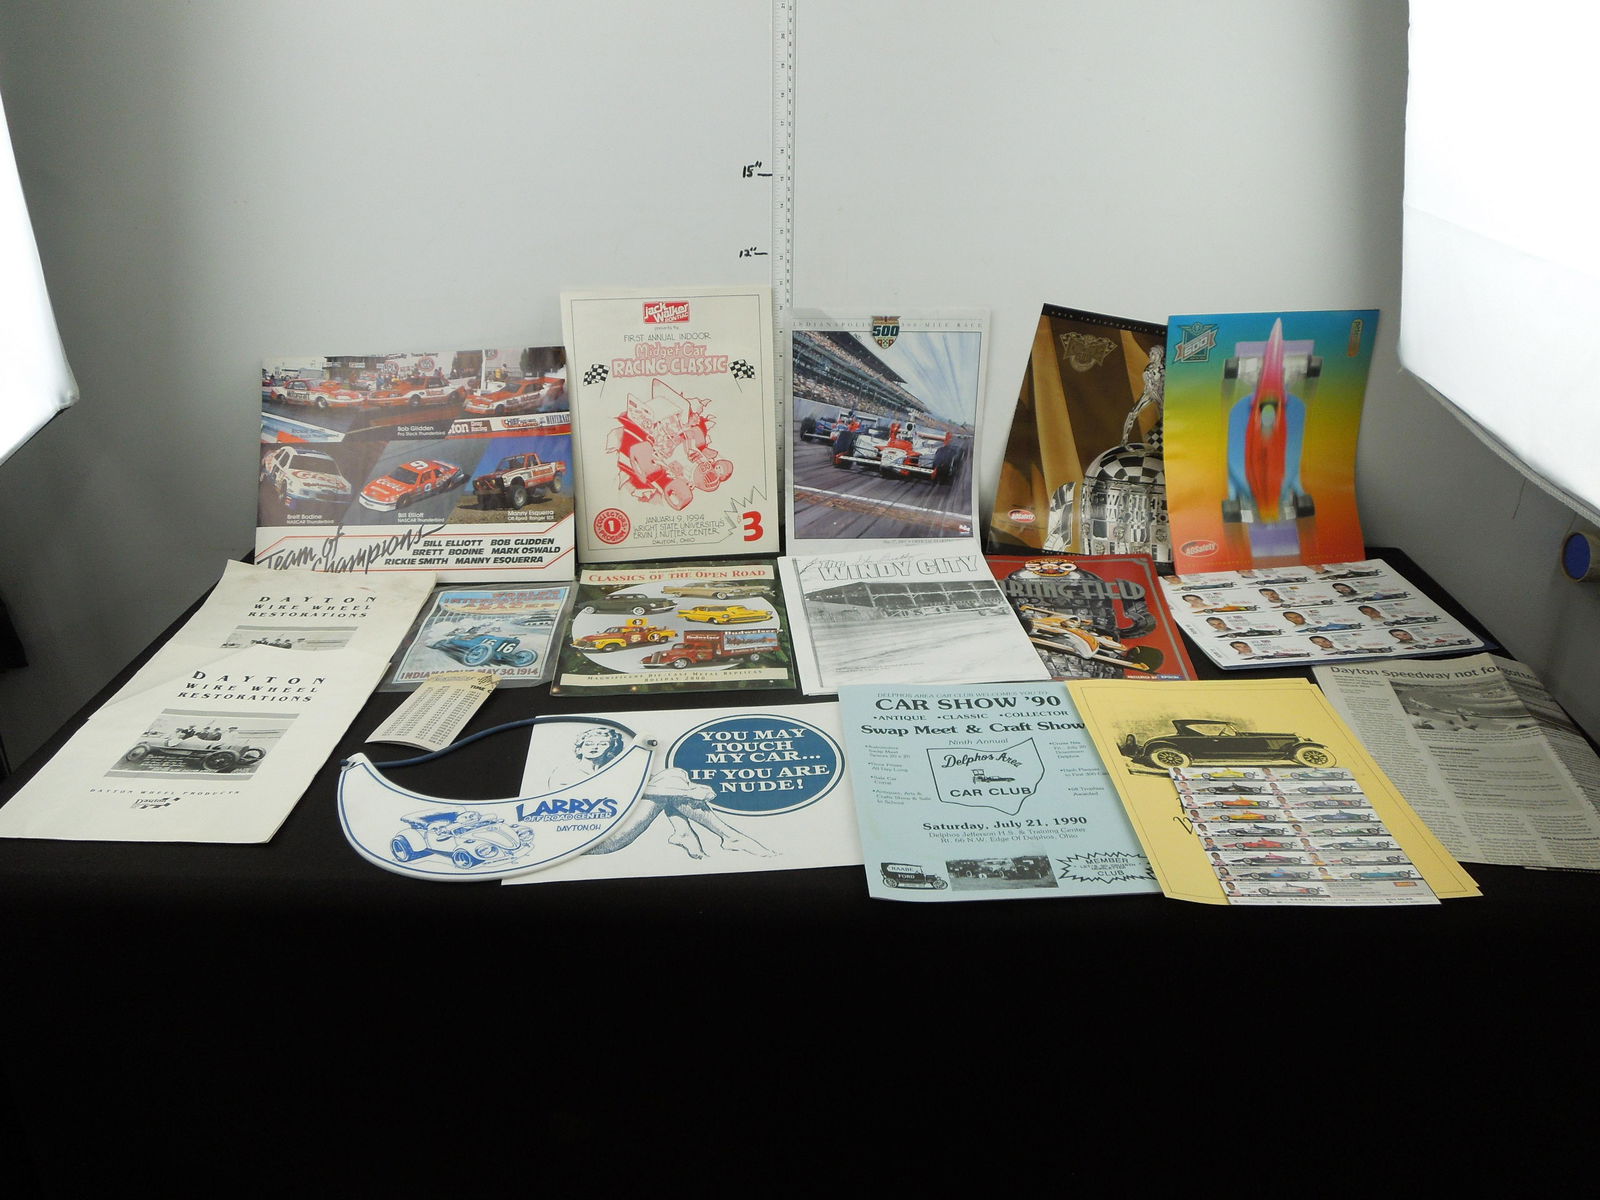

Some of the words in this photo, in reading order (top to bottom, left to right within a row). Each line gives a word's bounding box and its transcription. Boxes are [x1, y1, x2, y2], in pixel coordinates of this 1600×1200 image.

[653, 303, 689, 323] Walker
[647, 333, 675, 341] ANNUAL
[679, 331, 711, 340] INDOOR
[872, 325, 900, 337] 500
[635, 342, 681, 358] Midget
[682, 341, 707, 357] Car
[1184, 336, 1208, 354] 500
[612, 357, 669, 377] RACING
[670, 355, 728, 375] CLASSIC
[686, 513, 705, 521] 1994
[659, 522, 679, 530] STATE
[742, 511, 764, 542] 3
[660, 529, 686, 538] NUTTER
[688, 527, 720, 537] CENTER
[322, 522, 345, 559] of
[445, 539, 483, 547] ELLIOTT
[514, 538, 555, 546] GLIDDEN
[448, 548, 485, 556] BODINE
[491, 547, 520, 555] MARK
[521, 546, 561, 554] OSWALD
[256, 546, 317, 571] Team
[418, 557, 449, 565] SMITH
[454, 557, 491, 565] MANNY
[492, 556, 544, 564] ESQUERRA
[818, 560, 911, 581] WINDY
[917, 555, 978, 575] CITY
[1024, 562, 1077, 572] 500
[588, 574, 646, 582] CLASSICS
[669, 572, 690, 580] THE
[1083, 579, 1146, 600] FIELD
[258, 596, 376, 604] DAYTON
[481, 637, 497, 646] 16
[496, 642, 516, 654] 16
[191, 670, 326, 685] DAYTON
[516, 667, 539, 676] 1914
[1330, 666, 1379, 676] Dayton
[1381, 669, 1451, 680] Speedway
[1454, 669, 1479, 678] not
[185, 682, 236, 692] WIRE
[250, 685, 319, 693] WHEEL
[177, 692, 313, 703] RESTORATIONS
[875, 699, 930, 711] CAR
[938, 697, 1017, 710] SHOW
[1025, 695, 1062, 707] '90
[698, 731, 747, 741] YOU
[753, 728, 807, 740] MAY
[861, 724, 909, 737] Swap
[914, 724, 958, 735] Meet
[966, 724, 983, 734] &
[989, 722, 1033, 733] Craft
[1037, 720, 1086, 731] Show
[711, 740, 794, 752] TOUCH
[949, 738, 973, 746] Ninth
[705, 753, 746, 764] MY
[749, 750, 821, 763] CAR...
[941, 753, 995, 769] Delphos
[996, 752, 1023, 768] Area
[691, 769, 717, 780] IF
[720, 767, 772, 780] YOU
[776, 764, 830, 777] ARE
[719, 778, 804, 793] NUDE!
[949, 788, 983, 798] CAR
[988, 787, 1032, 796] CLUB
[544, 813, 574, 822] ROAD
[574, 812, 612, 820] CENTER
[922, 821, 989, 831] Saturday,
[994, 820, 1022, 829] July
[1025, 818, 1049, 827] 21,
[1053, 816, 1088, 826] 1990
[990, 836, 1010, 844] Edge
[1085, 857, 1129, 865] MEMBER
[1097, 869, 1125, 877] CLUB
